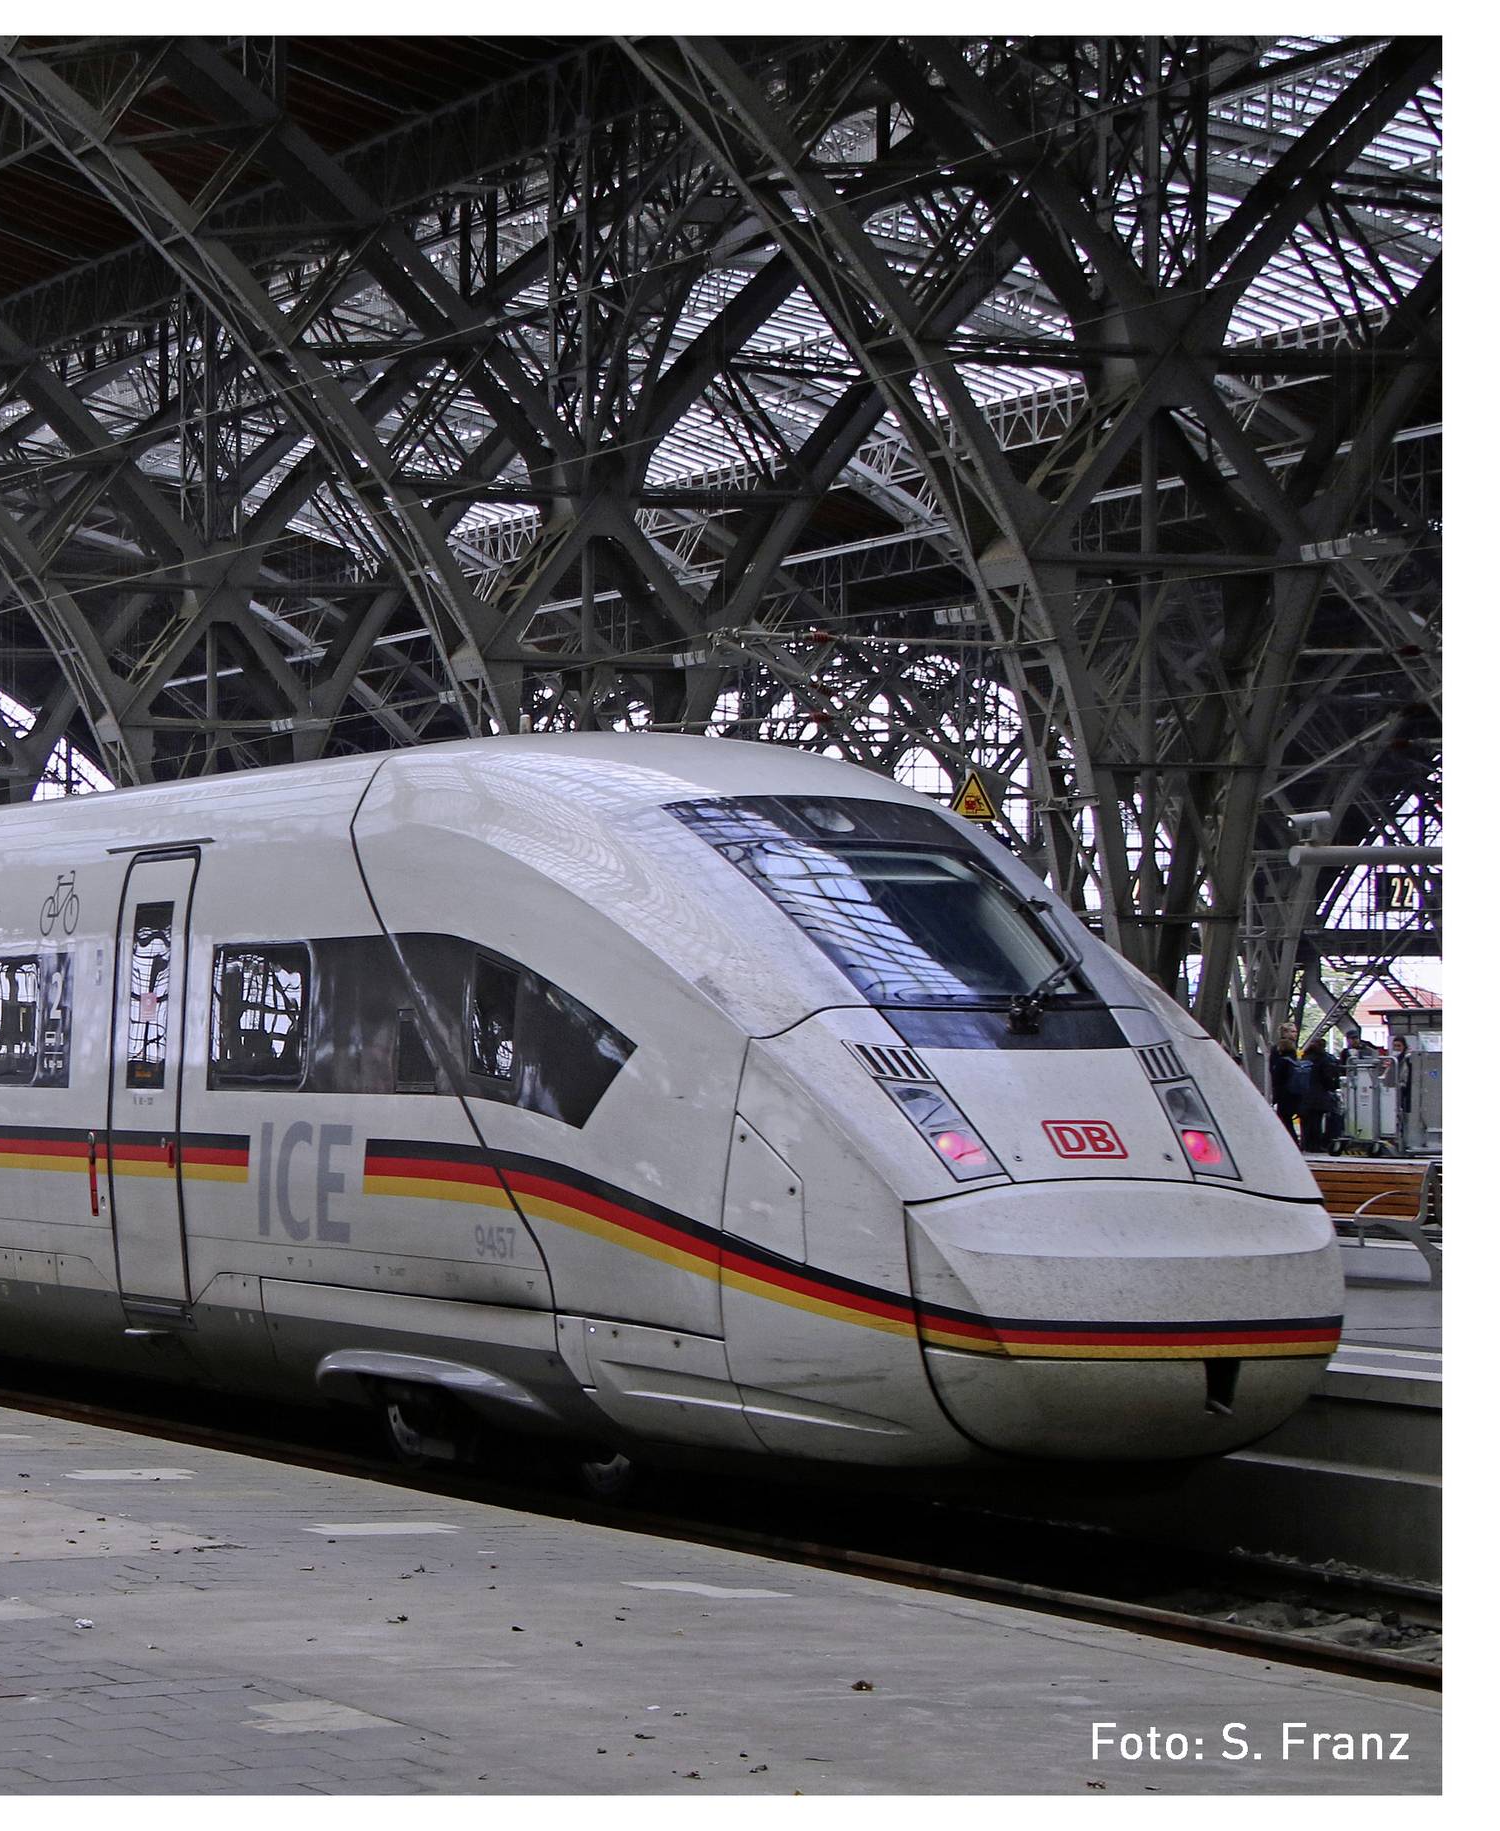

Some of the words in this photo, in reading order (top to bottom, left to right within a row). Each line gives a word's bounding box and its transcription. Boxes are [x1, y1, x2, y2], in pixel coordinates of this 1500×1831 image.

[1391, 877, 1414, 907] 22
[50, 971, 64, 1020] 2
[1049, 1124, 1119, 1155] DB
[258, 1120, 353, 1243] ICE
[475, 1224, 516, 1259] 9457
